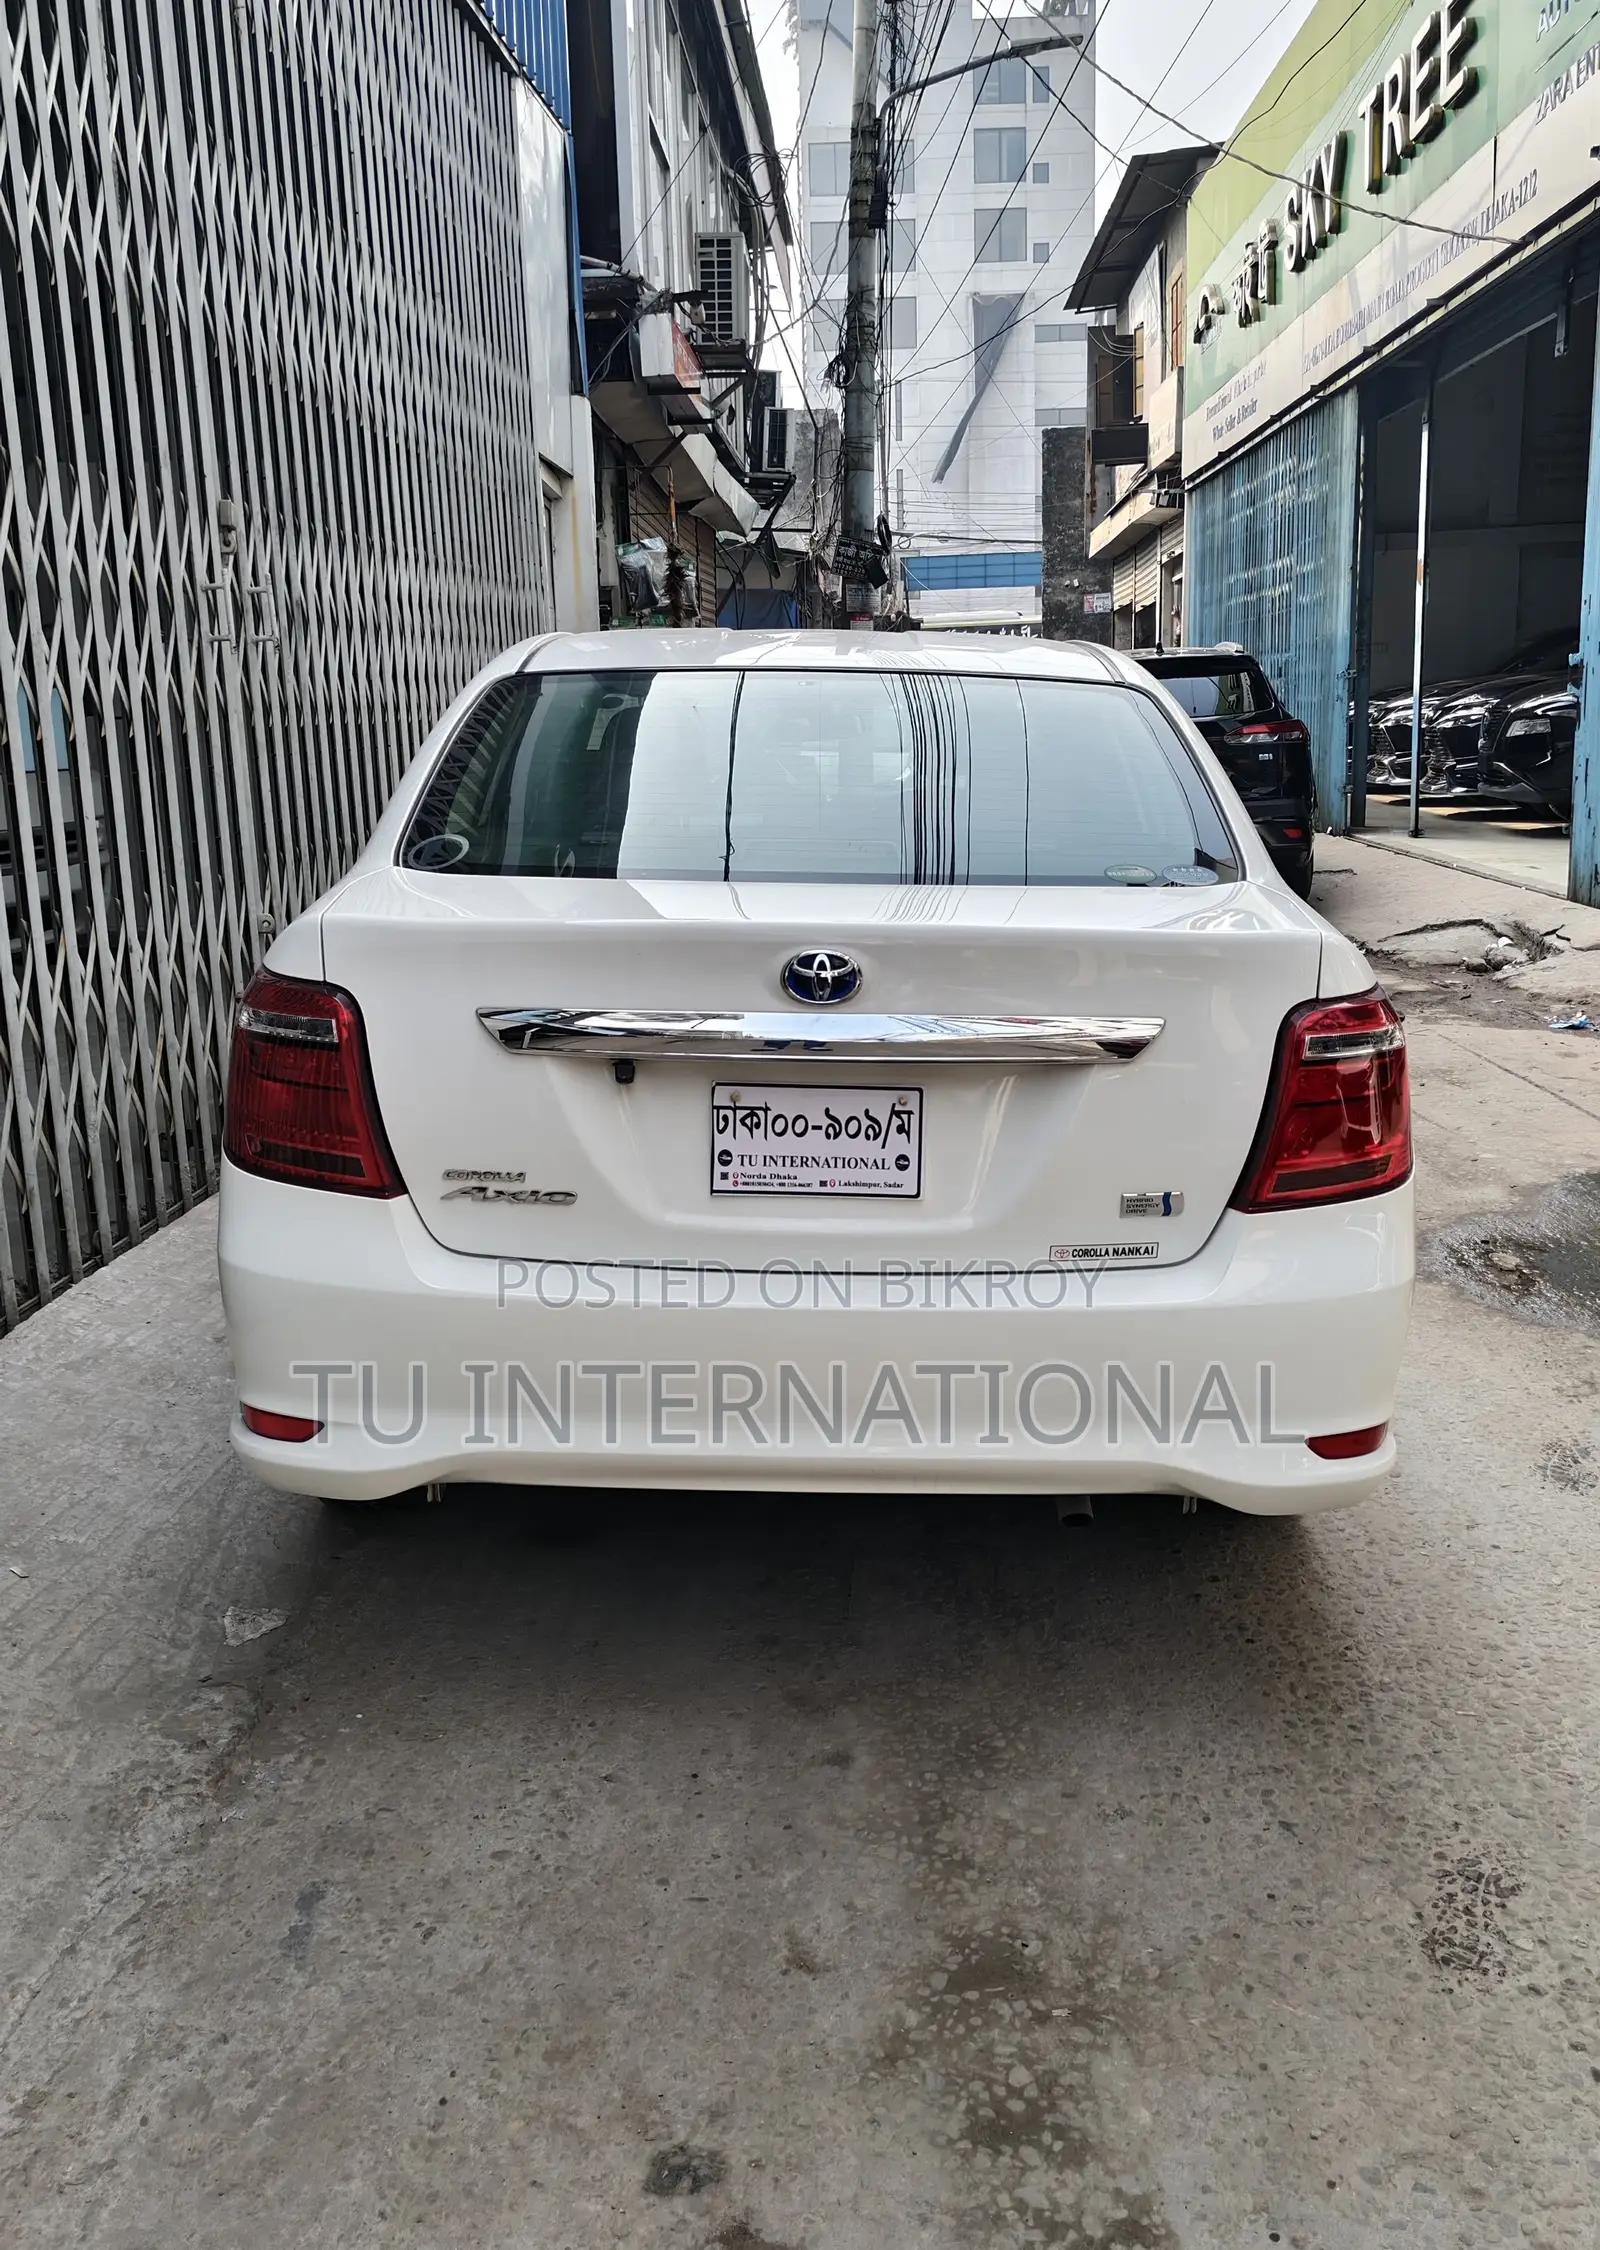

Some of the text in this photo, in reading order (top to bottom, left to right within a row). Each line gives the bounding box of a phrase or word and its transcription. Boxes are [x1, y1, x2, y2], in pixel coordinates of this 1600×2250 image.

[1284, 130, 1347, 273] SKY
[1357, 0, 1479, 195] TREE
[737, 1153, 891, 1171] TU INTERNATIONAL
[442, 1169, 527, 1183] COROLLA
[740, 1172, 798, 1181] Norda Dhaka
[883, 1181, 904, 1189] Sadar
[1071, 1246, 1154, 1258] COROLLA NANKAI
